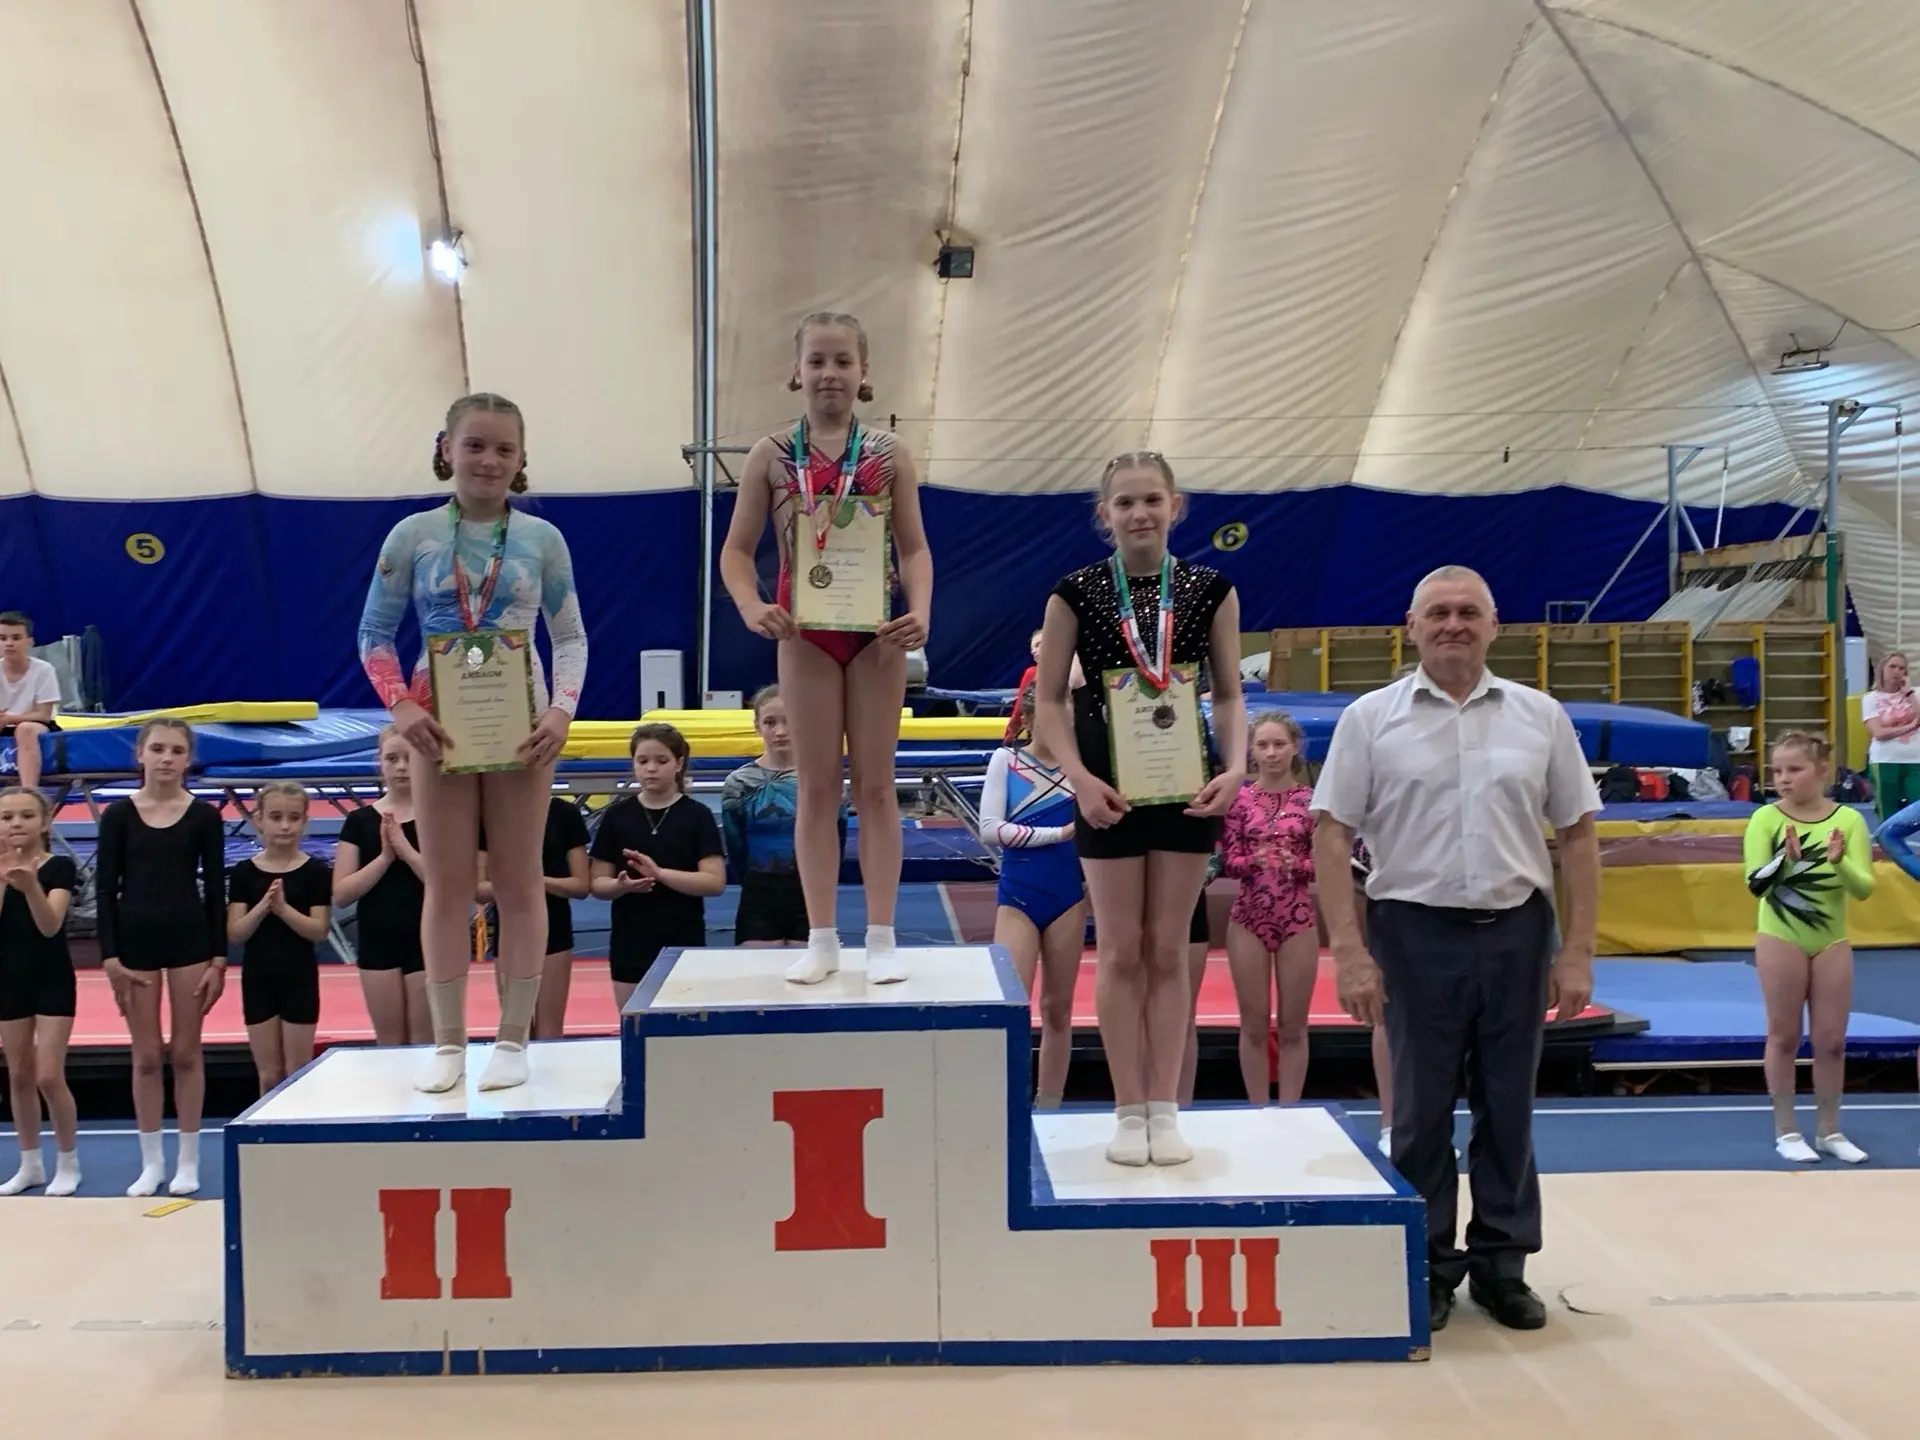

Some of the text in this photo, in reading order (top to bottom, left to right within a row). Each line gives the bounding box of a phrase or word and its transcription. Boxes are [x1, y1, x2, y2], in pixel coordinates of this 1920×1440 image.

[136, 538, 156, 558] 5
[1222, 526, 1240, 547] 6
[773, 1089, 886, 1251] I
[379, 1188, 512, 1299] II
[1150, 1238, 1281, 1327] III
